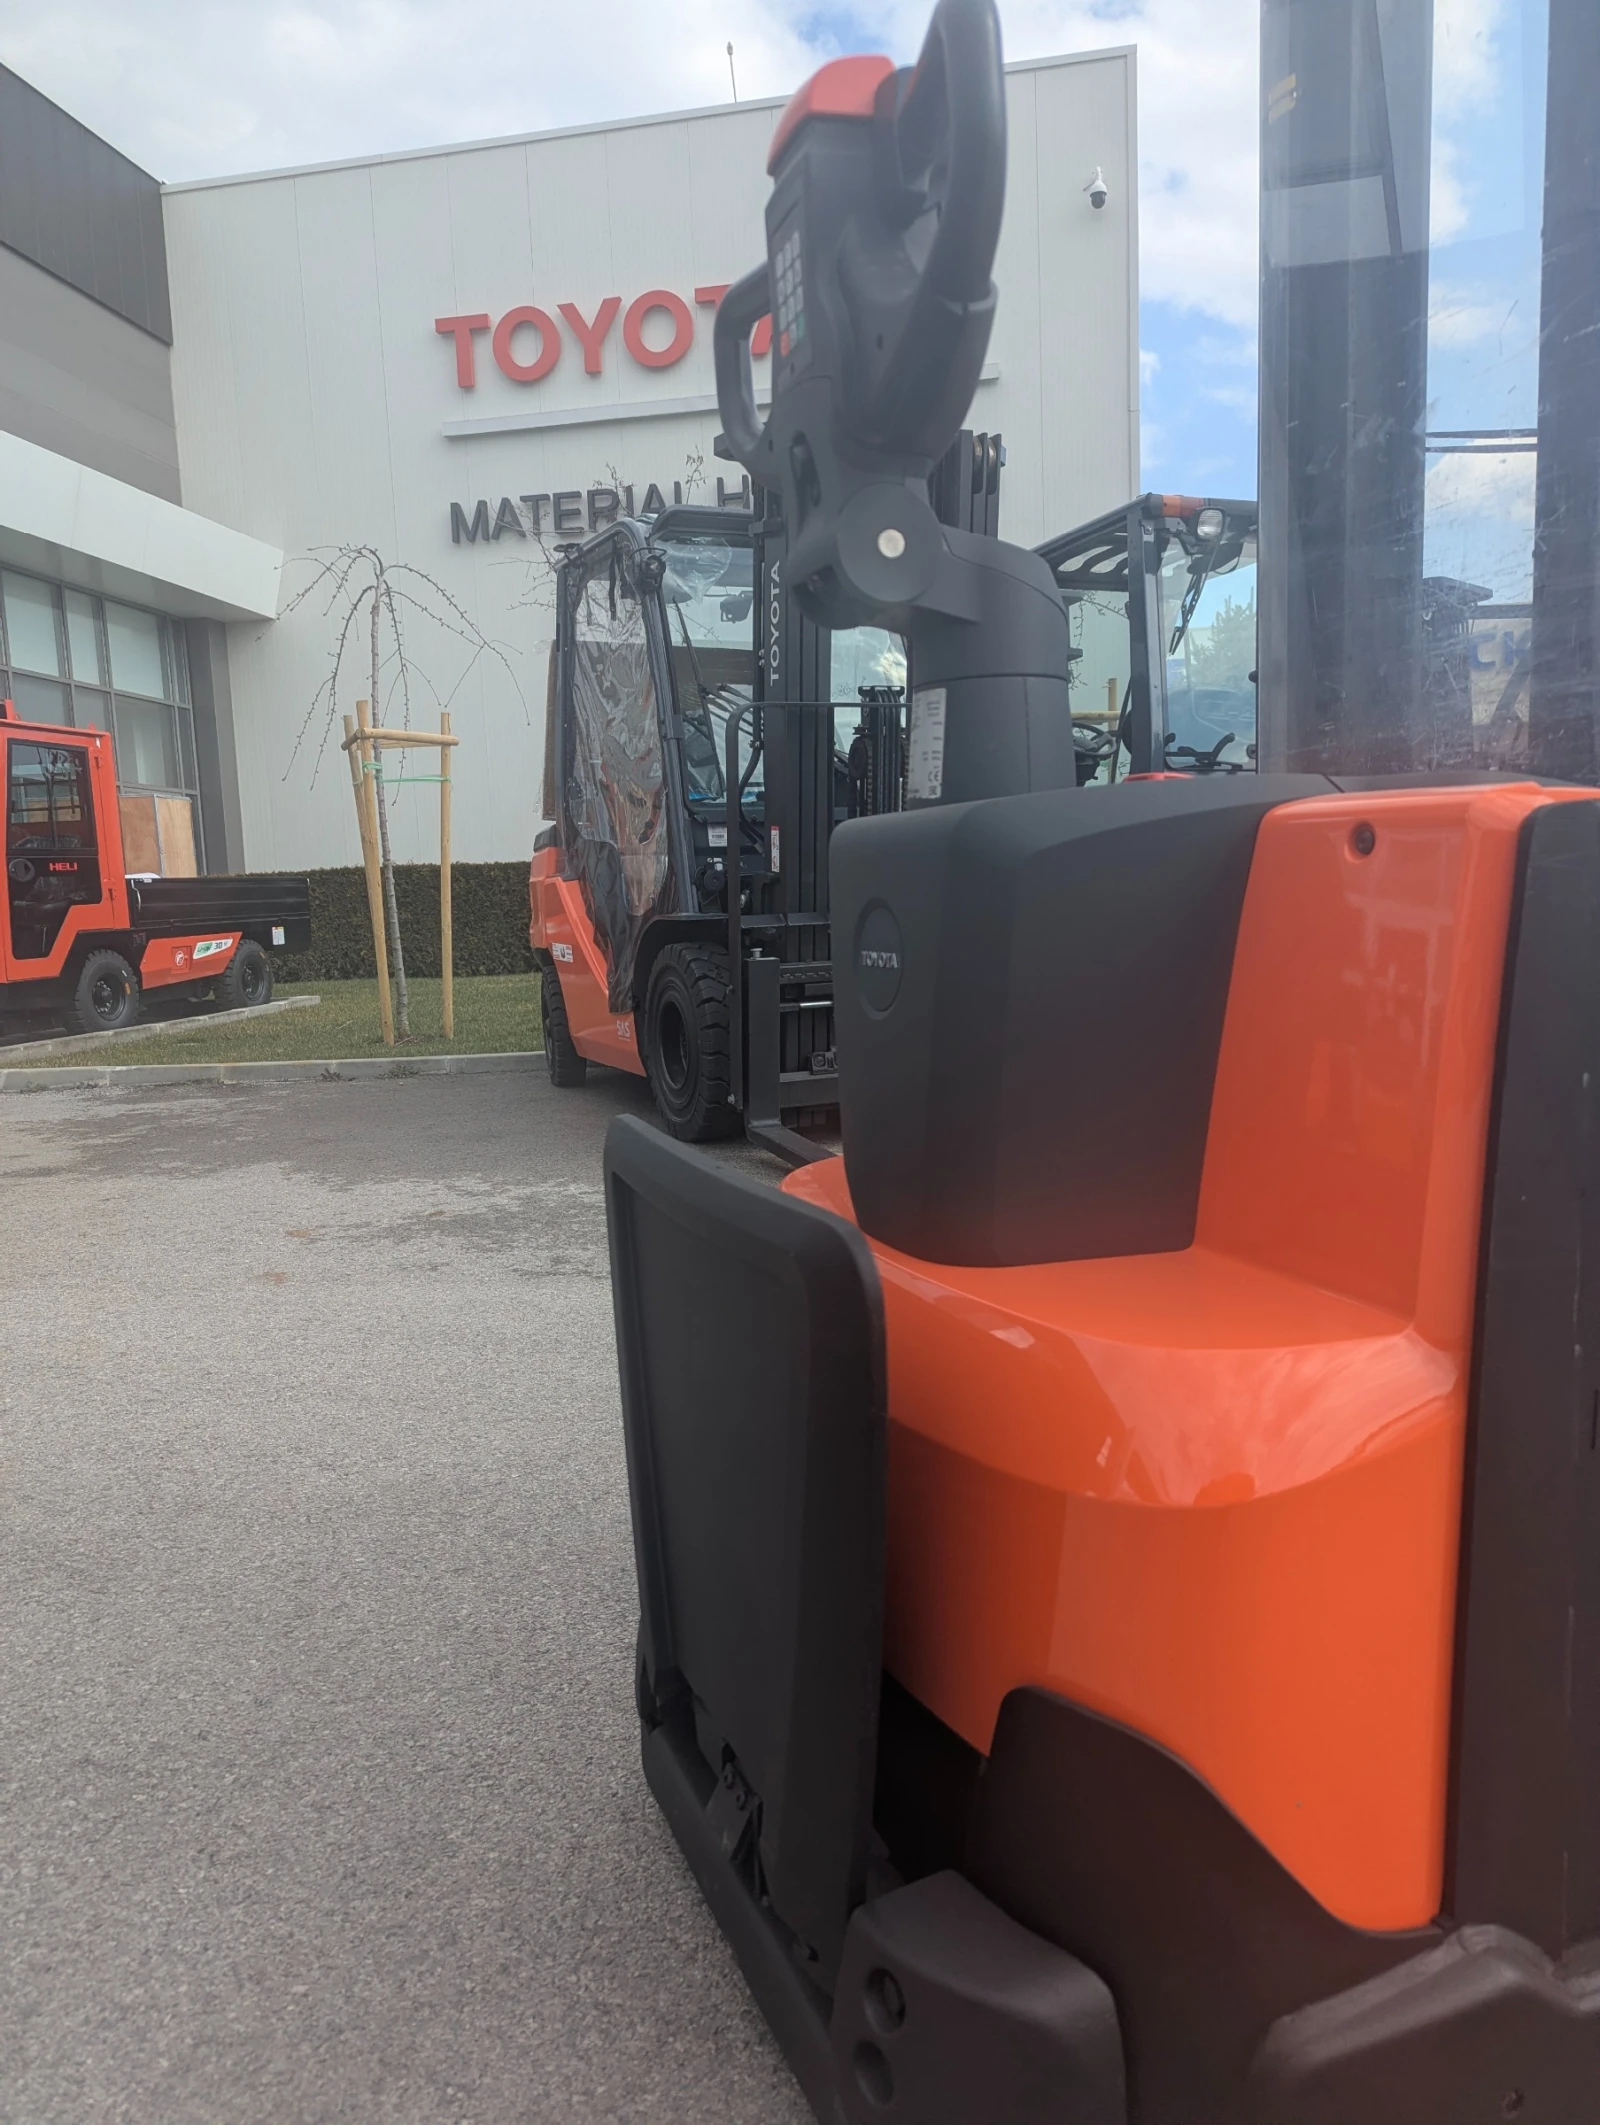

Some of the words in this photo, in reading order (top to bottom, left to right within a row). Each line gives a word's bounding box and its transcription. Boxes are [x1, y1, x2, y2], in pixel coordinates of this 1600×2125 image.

[770, 560, 780, 687] TOYOTA
[49, 862, 78, 871] HELI
[861, 950, 898, 968] TOYOTA
